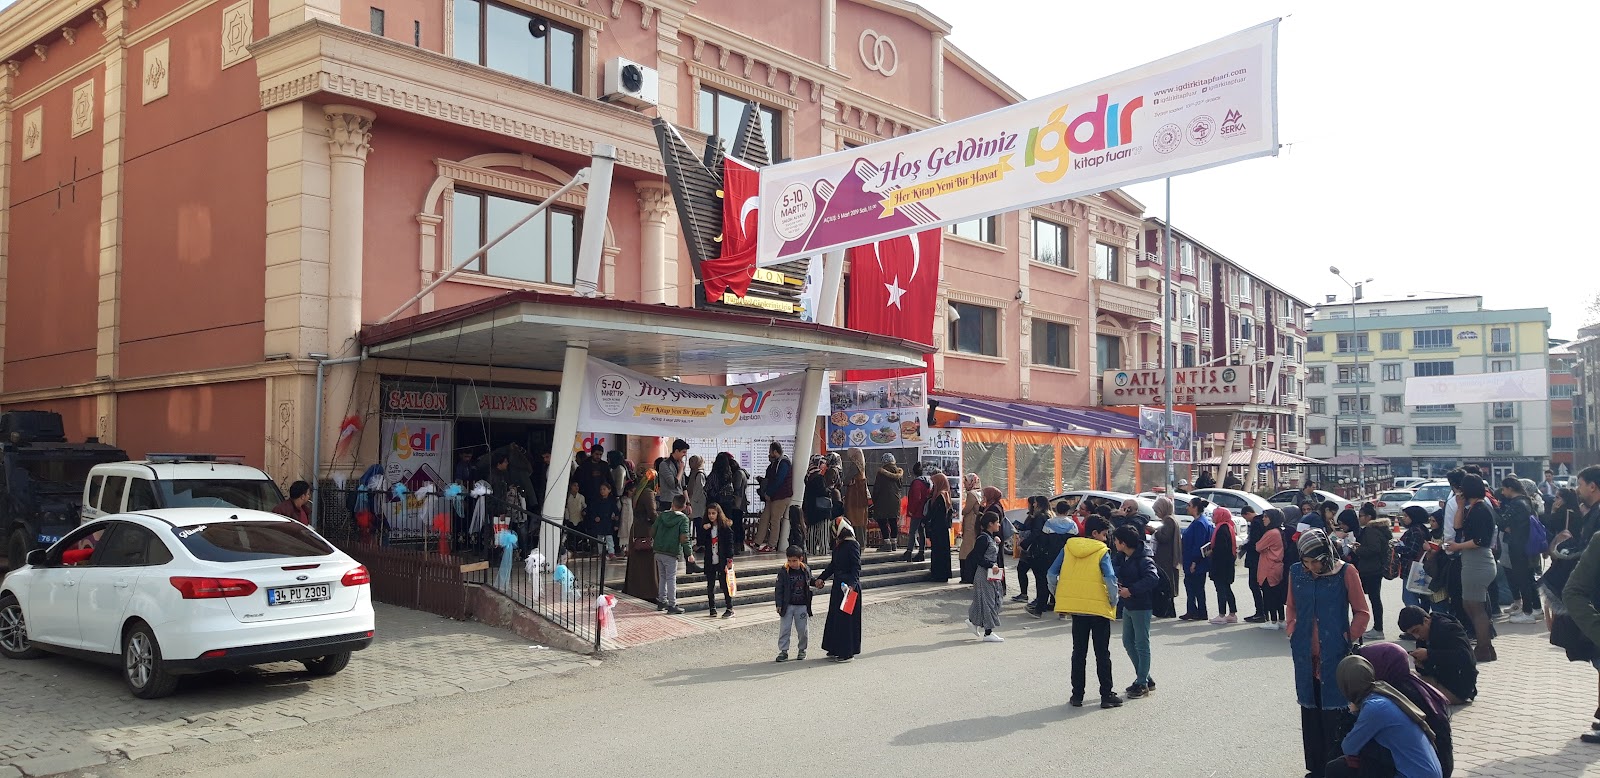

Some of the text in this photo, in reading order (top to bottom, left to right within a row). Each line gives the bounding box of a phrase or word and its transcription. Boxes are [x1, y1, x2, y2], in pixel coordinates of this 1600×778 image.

[1153, 68, 1247, 97] www.igdirkitapfuari.com
[1220, 123, 1247, 135] SERKA
[875, 131, 1018, 189] Hoş Geldiniz
[1074, 154, 1105, 171] kitap
[1105, 148, 1132, 163] fuarı
[894, 168, 999, 205] Her Kitap Yeni Bir Hayat
[782, 189, 803, 208] 5-10
[780, 201, 809, 218] MART'19
[757, 269, 783, 284] LON
[601, 379, 622, 390] 5-10
[1129, 368, 1217, 386] ATLNTİS
[601, 389, 625, 397] MART'19
[1114, 385, 1238, 396] OYUN ÜNYASI
[390, 390, 539, 412] SALON ALYANS
[1152, 395, 1195, 403] CFE
[929, 436, 960, 449] tlantis
[274, 590, 286, 601] 34
[290, 588, 301, 600] PU
[304, 586, 327, 599] 2309
